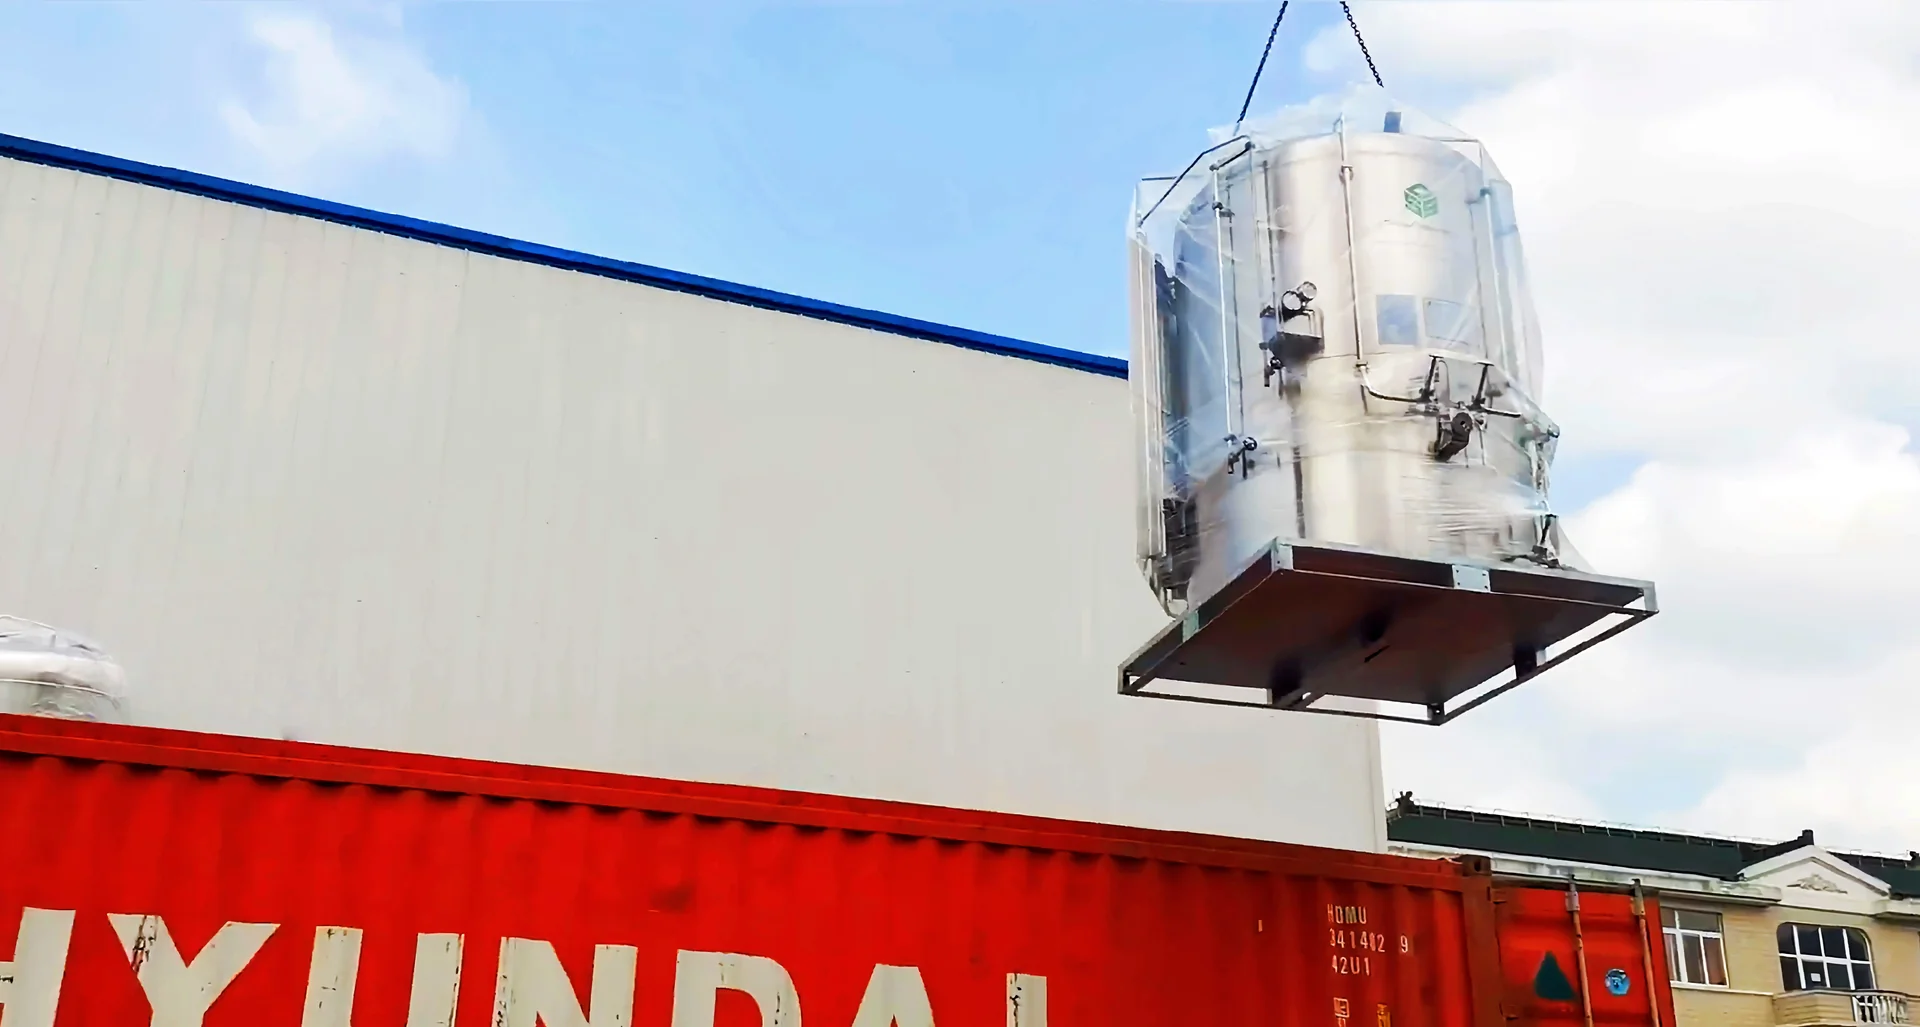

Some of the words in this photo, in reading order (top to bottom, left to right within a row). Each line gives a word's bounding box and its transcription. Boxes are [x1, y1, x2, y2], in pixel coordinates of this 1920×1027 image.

[1327, 904, 1367, 924] HDMU
[1400, 935, 1409, 953] 9
[1332, 955, 1370, 976] 42U1
